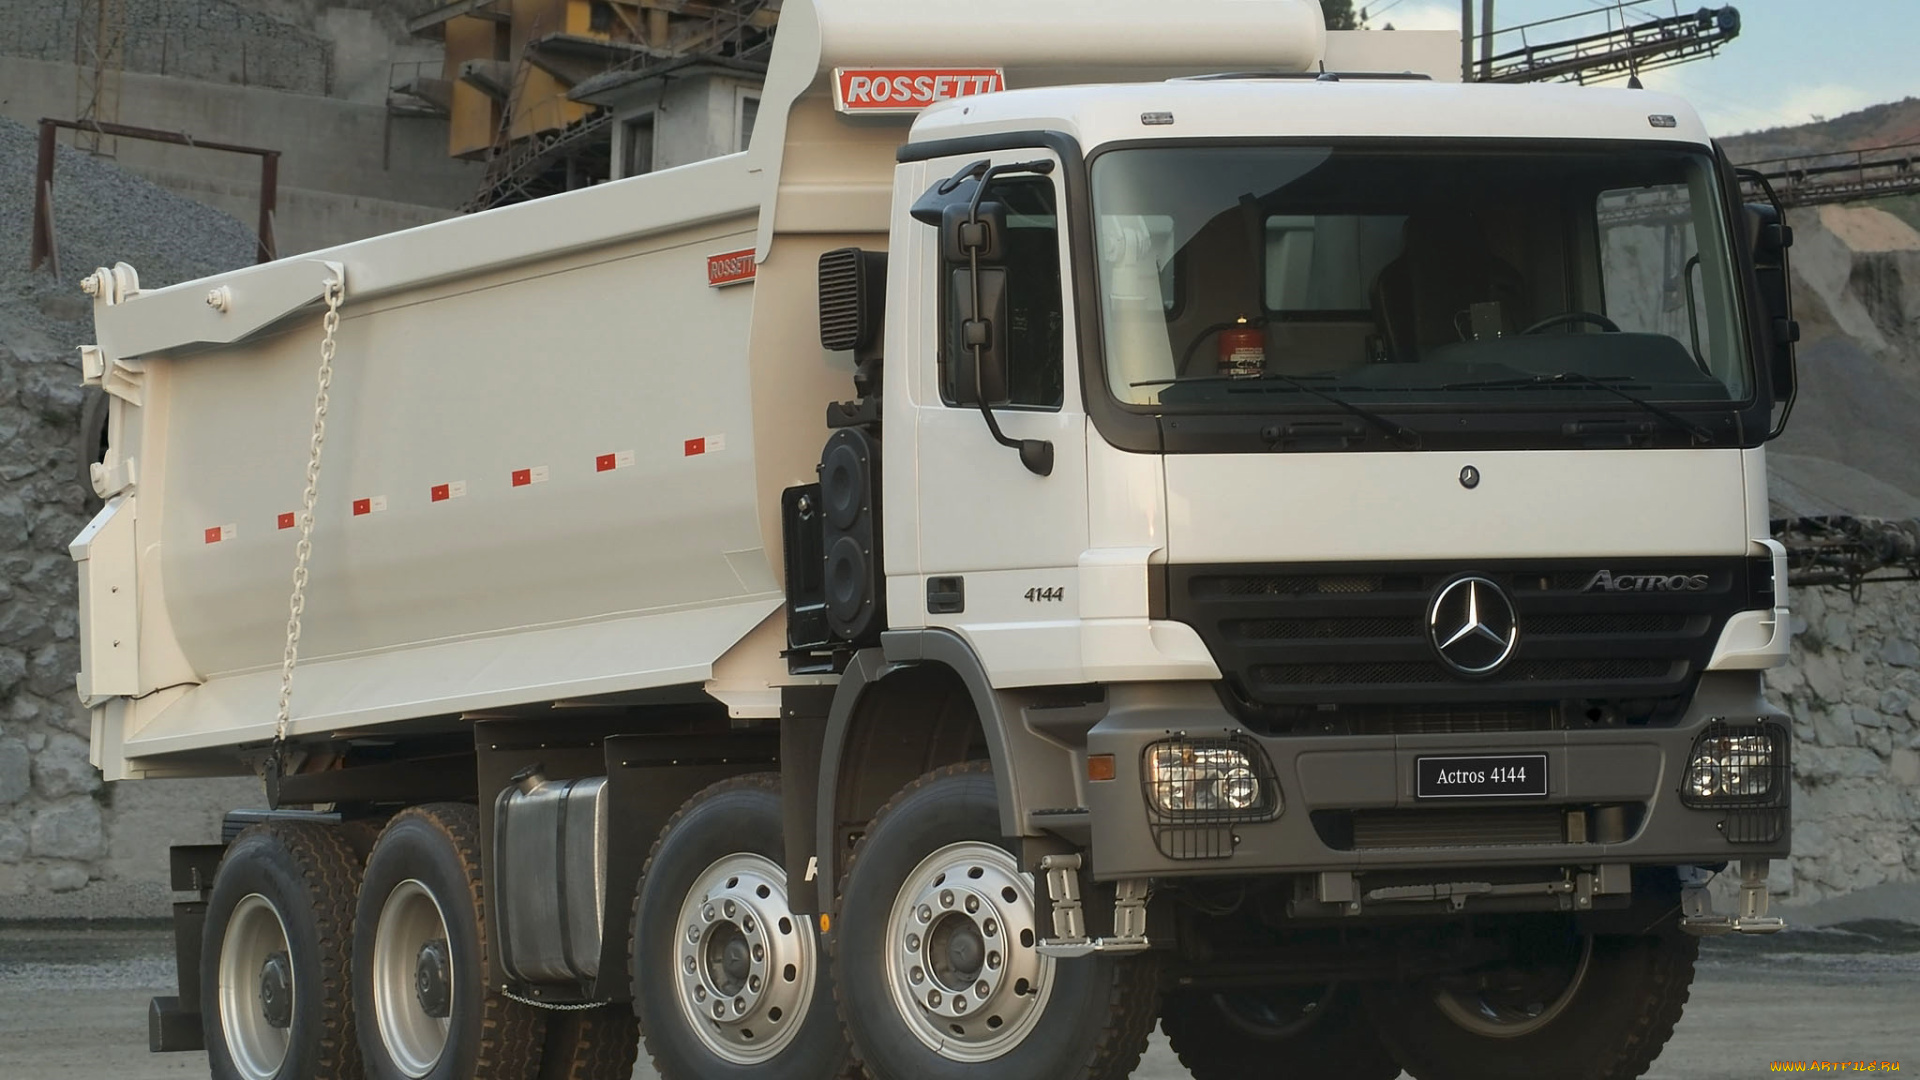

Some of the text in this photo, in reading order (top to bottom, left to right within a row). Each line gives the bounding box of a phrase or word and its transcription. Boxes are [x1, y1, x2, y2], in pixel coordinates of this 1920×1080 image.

[847, 75, 998, 103] ROSSETTI
[1581, 569, 1709, 593] ACTROS
[1024, 586, 1064, 602] 4144
[1437, 766, 1527, 784] Actros 4144
